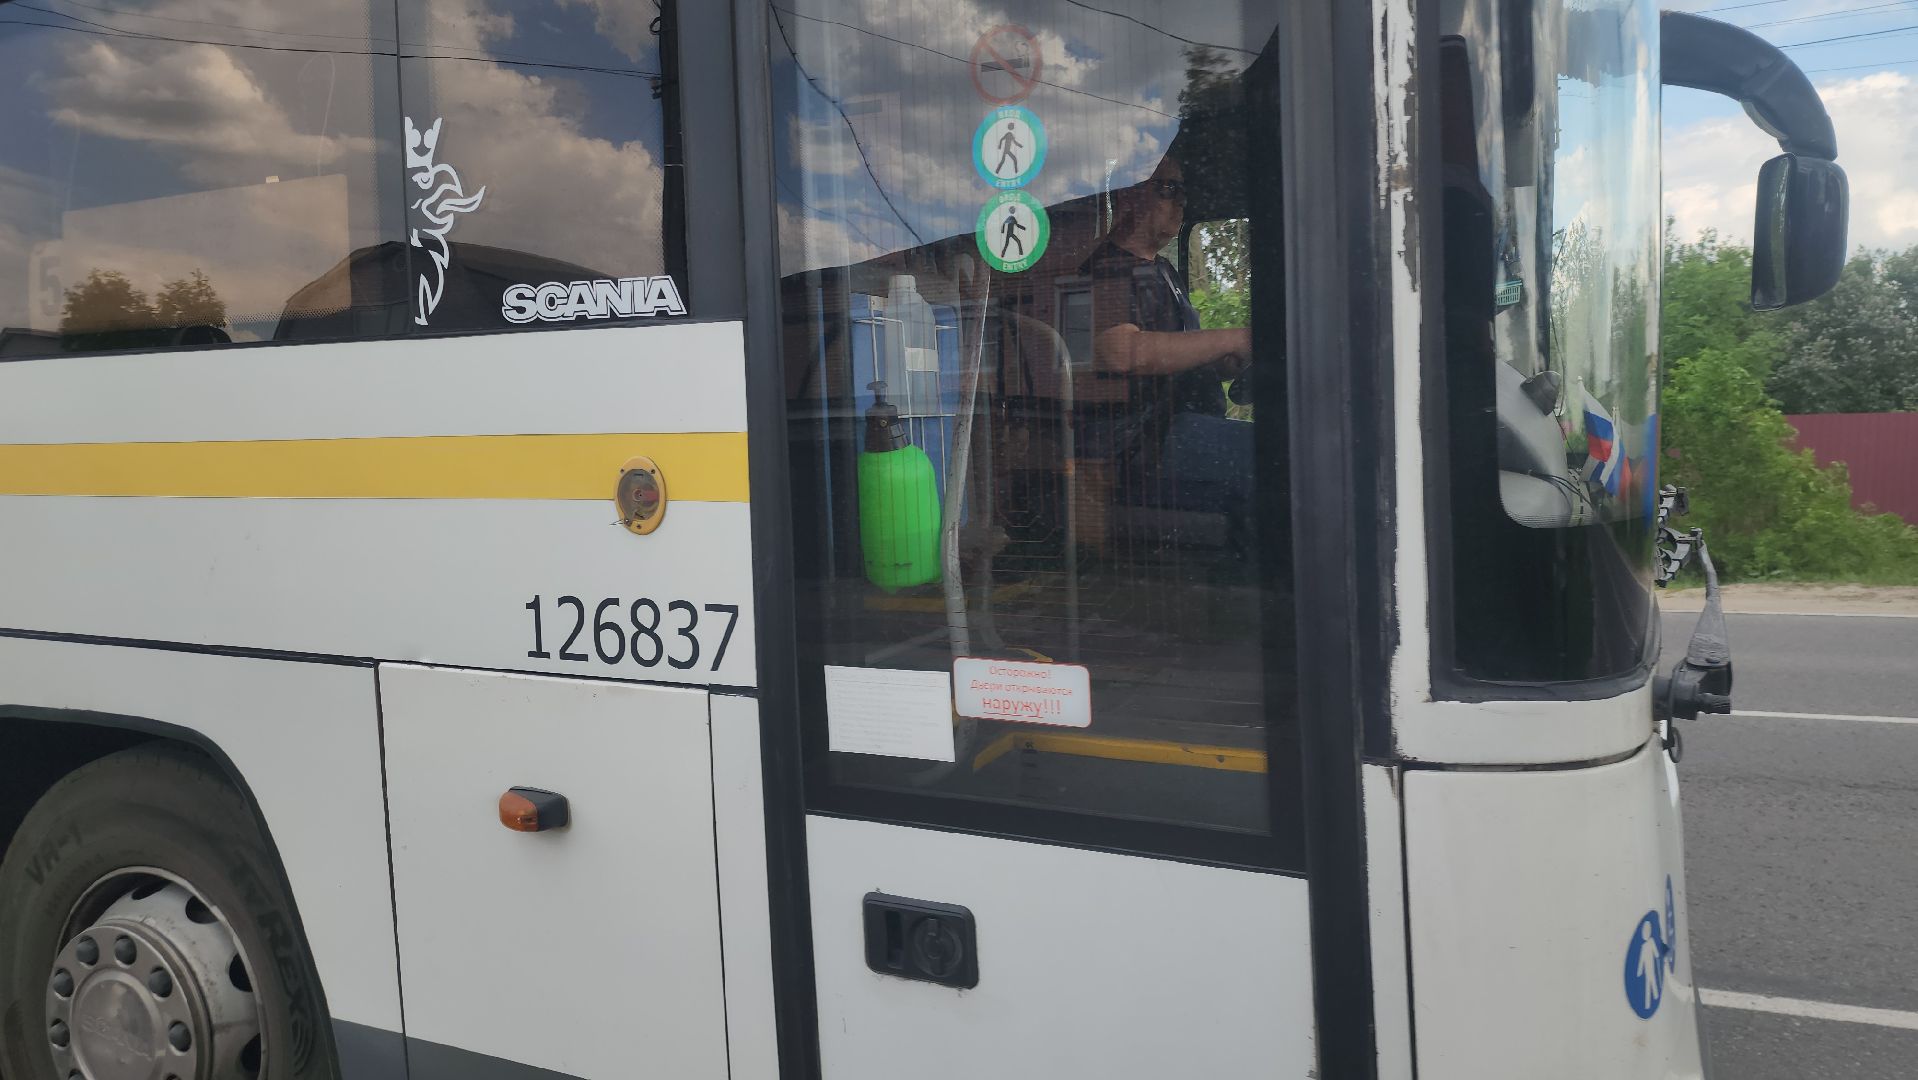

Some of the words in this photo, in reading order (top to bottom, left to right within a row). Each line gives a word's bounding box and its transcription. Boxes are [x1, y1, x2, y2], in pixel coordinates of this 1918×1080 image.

[995, 177, 1022, 188] ENTRY
[1002, 259, 1028, 271] ENTRY
[502, 275, 687, 324] SCANIA
[525, 594, 739, 672] 126837
[989, 665, 1051, 679] Осторожно!
[970, 679, 1003, 692] Двери
[982, 697, 1061, 716] наружу!!!
